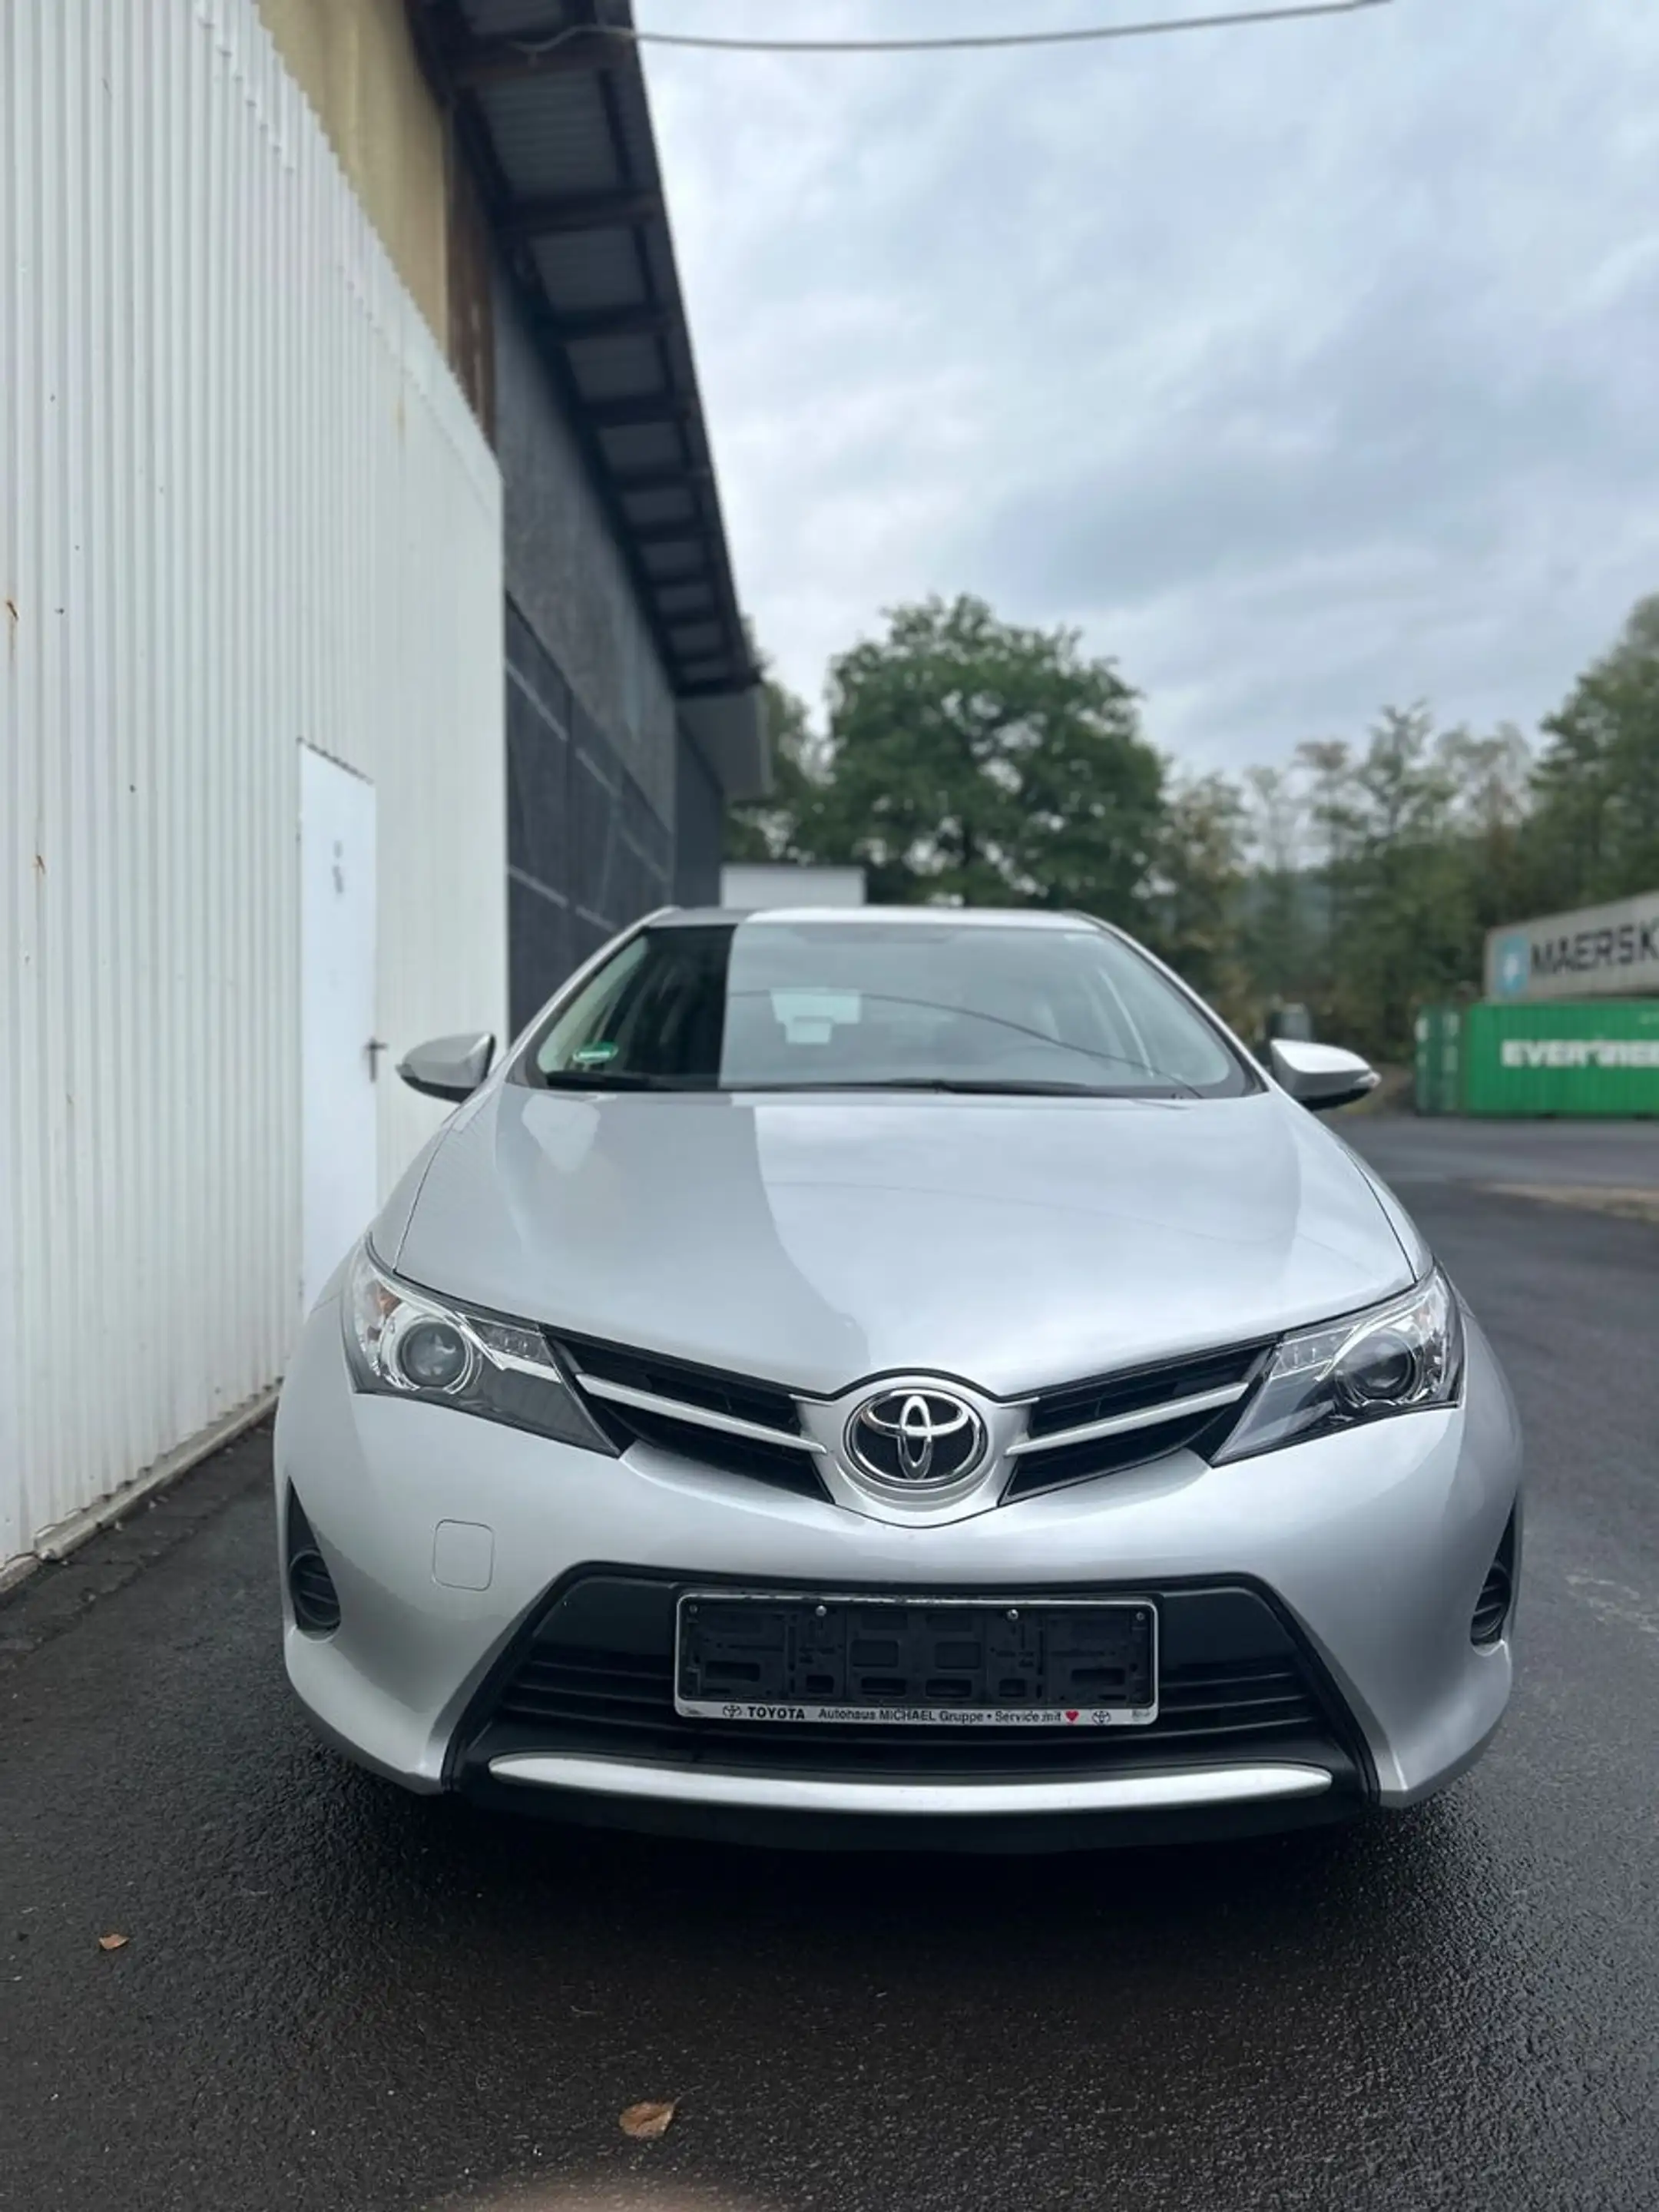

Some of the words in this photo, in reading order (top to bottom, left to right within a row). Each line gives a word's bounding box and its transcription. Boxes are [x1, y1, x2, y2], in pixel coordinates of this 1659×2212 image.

[1531, 919, 1659, 975] MAERSK
[747, 1706, 805, 1720] TOYOTA
[818, 1707, 876, 1720] Autohaus
[879, 1709, 935, 1722] MICHAEL
[939, 1710, 984, 1724] Gruppe
[995, 1710, 1039, 1723] Service
